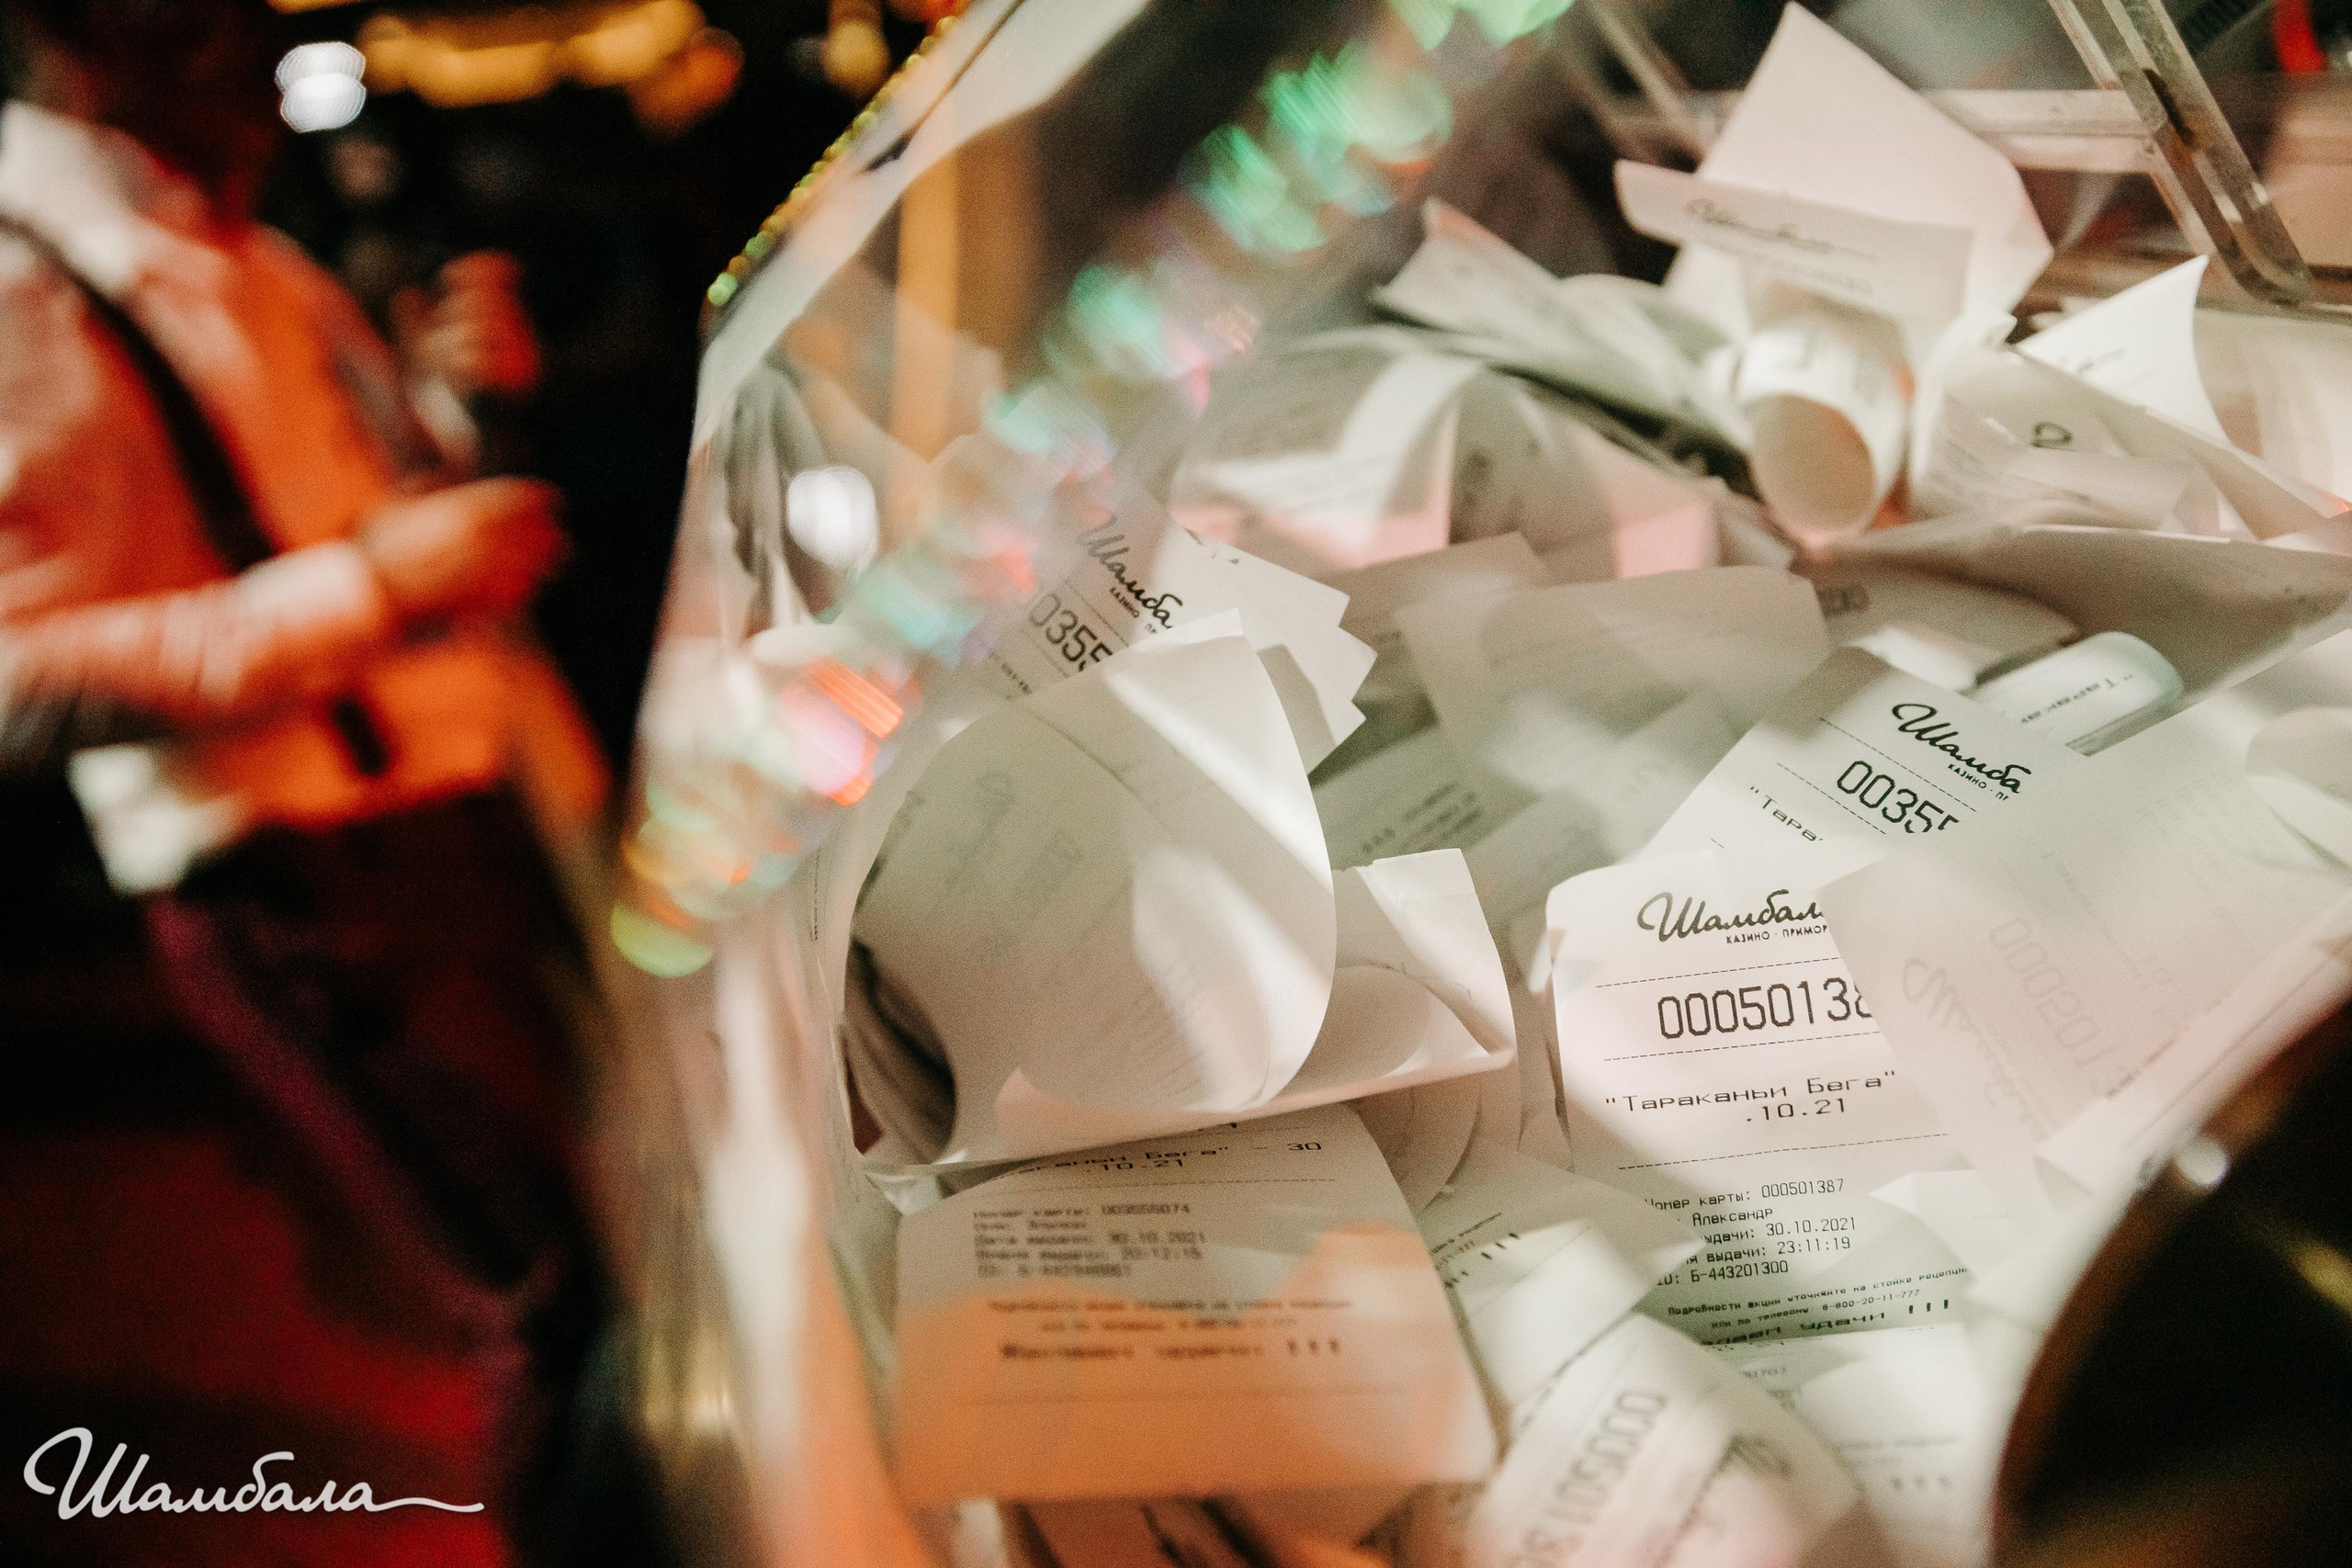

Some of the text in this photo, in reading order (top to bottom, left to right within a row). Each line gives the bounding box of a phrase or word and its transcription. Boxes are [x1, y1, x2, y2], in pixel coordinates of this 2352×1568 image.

[1947, 762, 1988, 789] КАЗИНО
[1749, 785, 1824, 841] "Тара
[1636, 888, 1825, 943] Шамбал
[1725, 931, 1771, 945] КАЗИНО
[1806, 1070, 1896, 1095] Бега"
[1746, 1098, 1846, 1122] .10.21
[1287, 1141, 1323, 1152] 30
[1699, 1190, 1751, 1207] карты:
[1761, 1178, 1845, 1199] 000501387
[1692, 1208, 1774, 1227] Александр
[1700, 1216, 1856, 1245] ыдачи: 30.10.2021
[1706, 1246, 1767, 1263] выдачи:
[1777, 1235, 1851, 1256] 23:11:19
[1690, 1259, 1789, 1283] Б-443201300
[1668, 1302, 1742, 1316] Подробности
